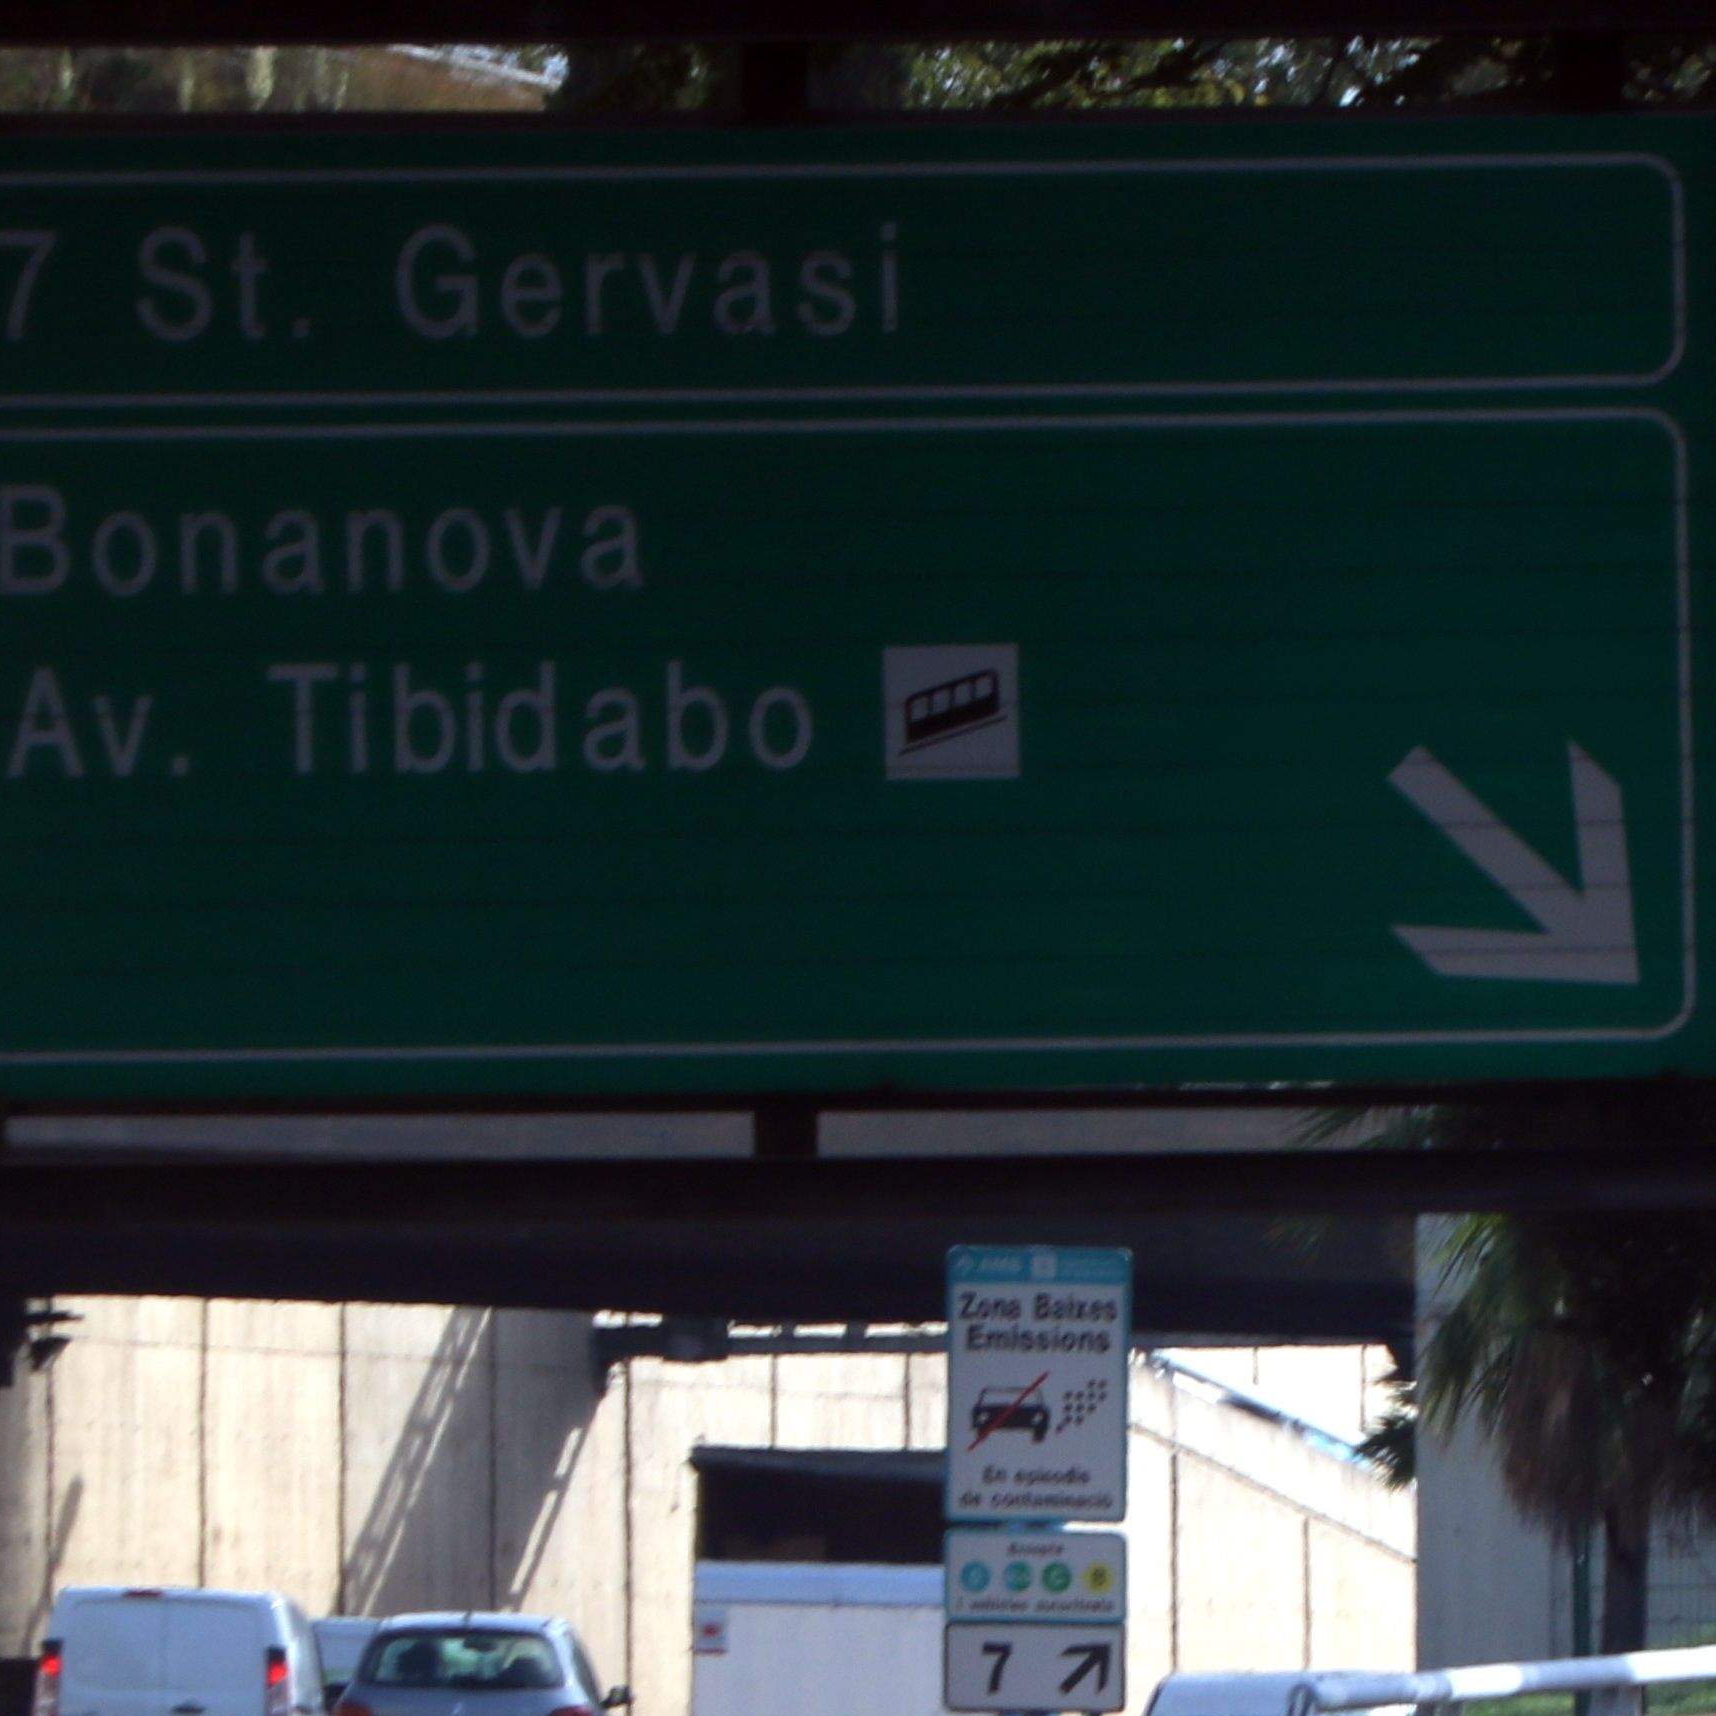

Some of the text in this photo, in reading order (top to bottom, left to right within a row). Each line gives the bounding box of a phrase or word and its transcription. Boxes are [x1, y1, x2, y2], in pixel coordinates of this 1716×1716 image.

[135, 226, 314, 341] St.
[395, 222, 904, 340] Gervasi
[6, 660, 817, 781] Av. Tibidabo
[958, 1290, 1118, 1322] Zona Baixes
[965, 1322, 1112, 1354] Emissions
[982, 1640, 1013, 1694] 7
